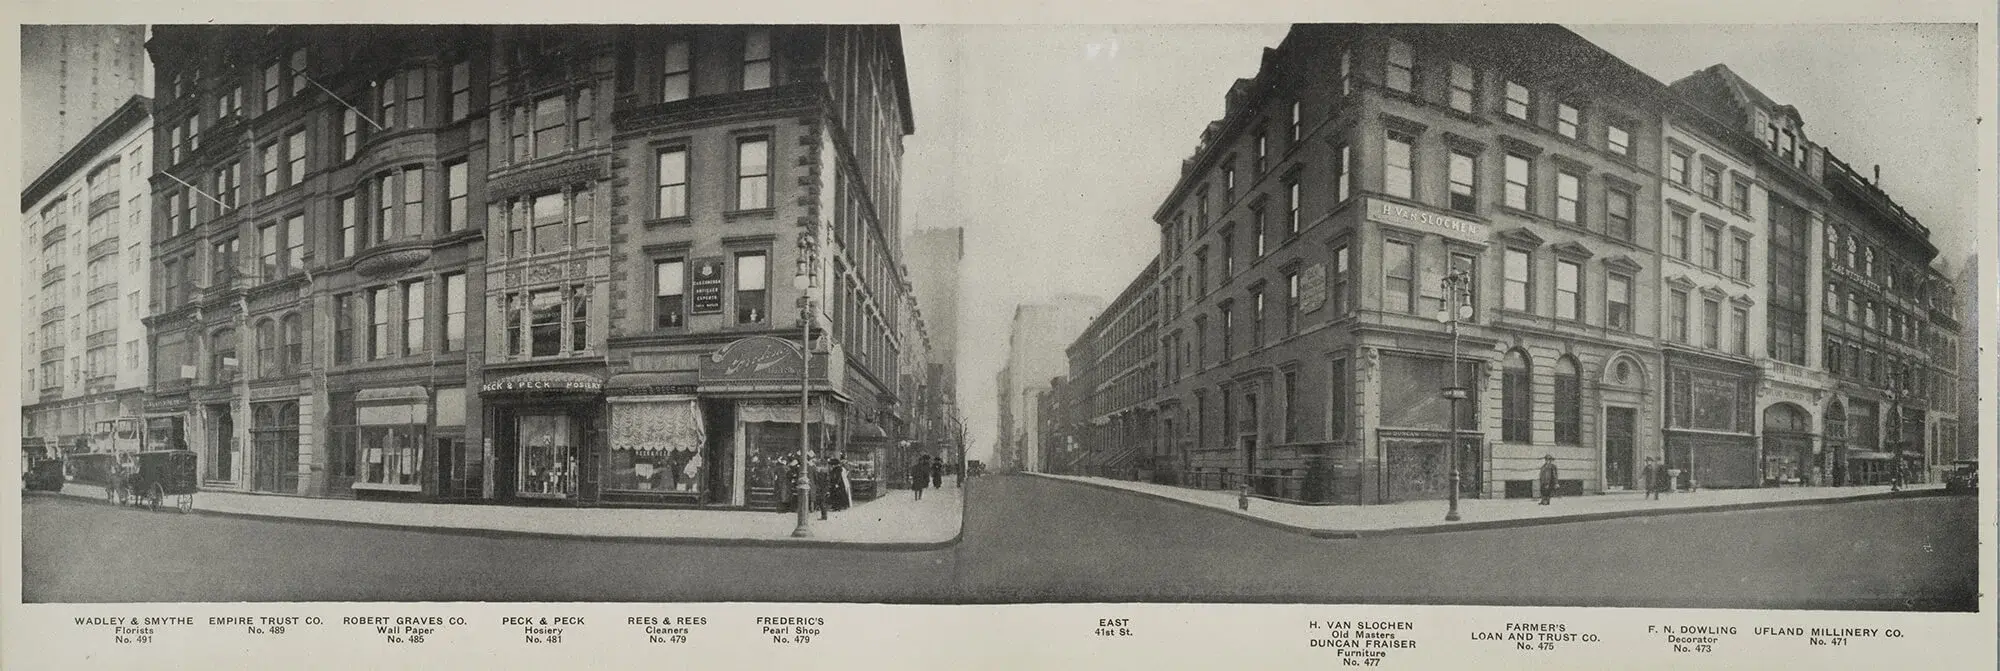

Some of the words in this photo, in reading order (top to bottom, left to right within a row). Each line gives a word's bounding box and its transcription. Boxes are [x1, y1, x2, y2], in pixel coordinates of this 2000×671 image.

[1395, 207, 1418, 221] VAN
[1421, 213, 1476, 234] SLOCHEN
[483, 382, 502, 391] PECK
[566, 381, 601, 389] HOSIERY
